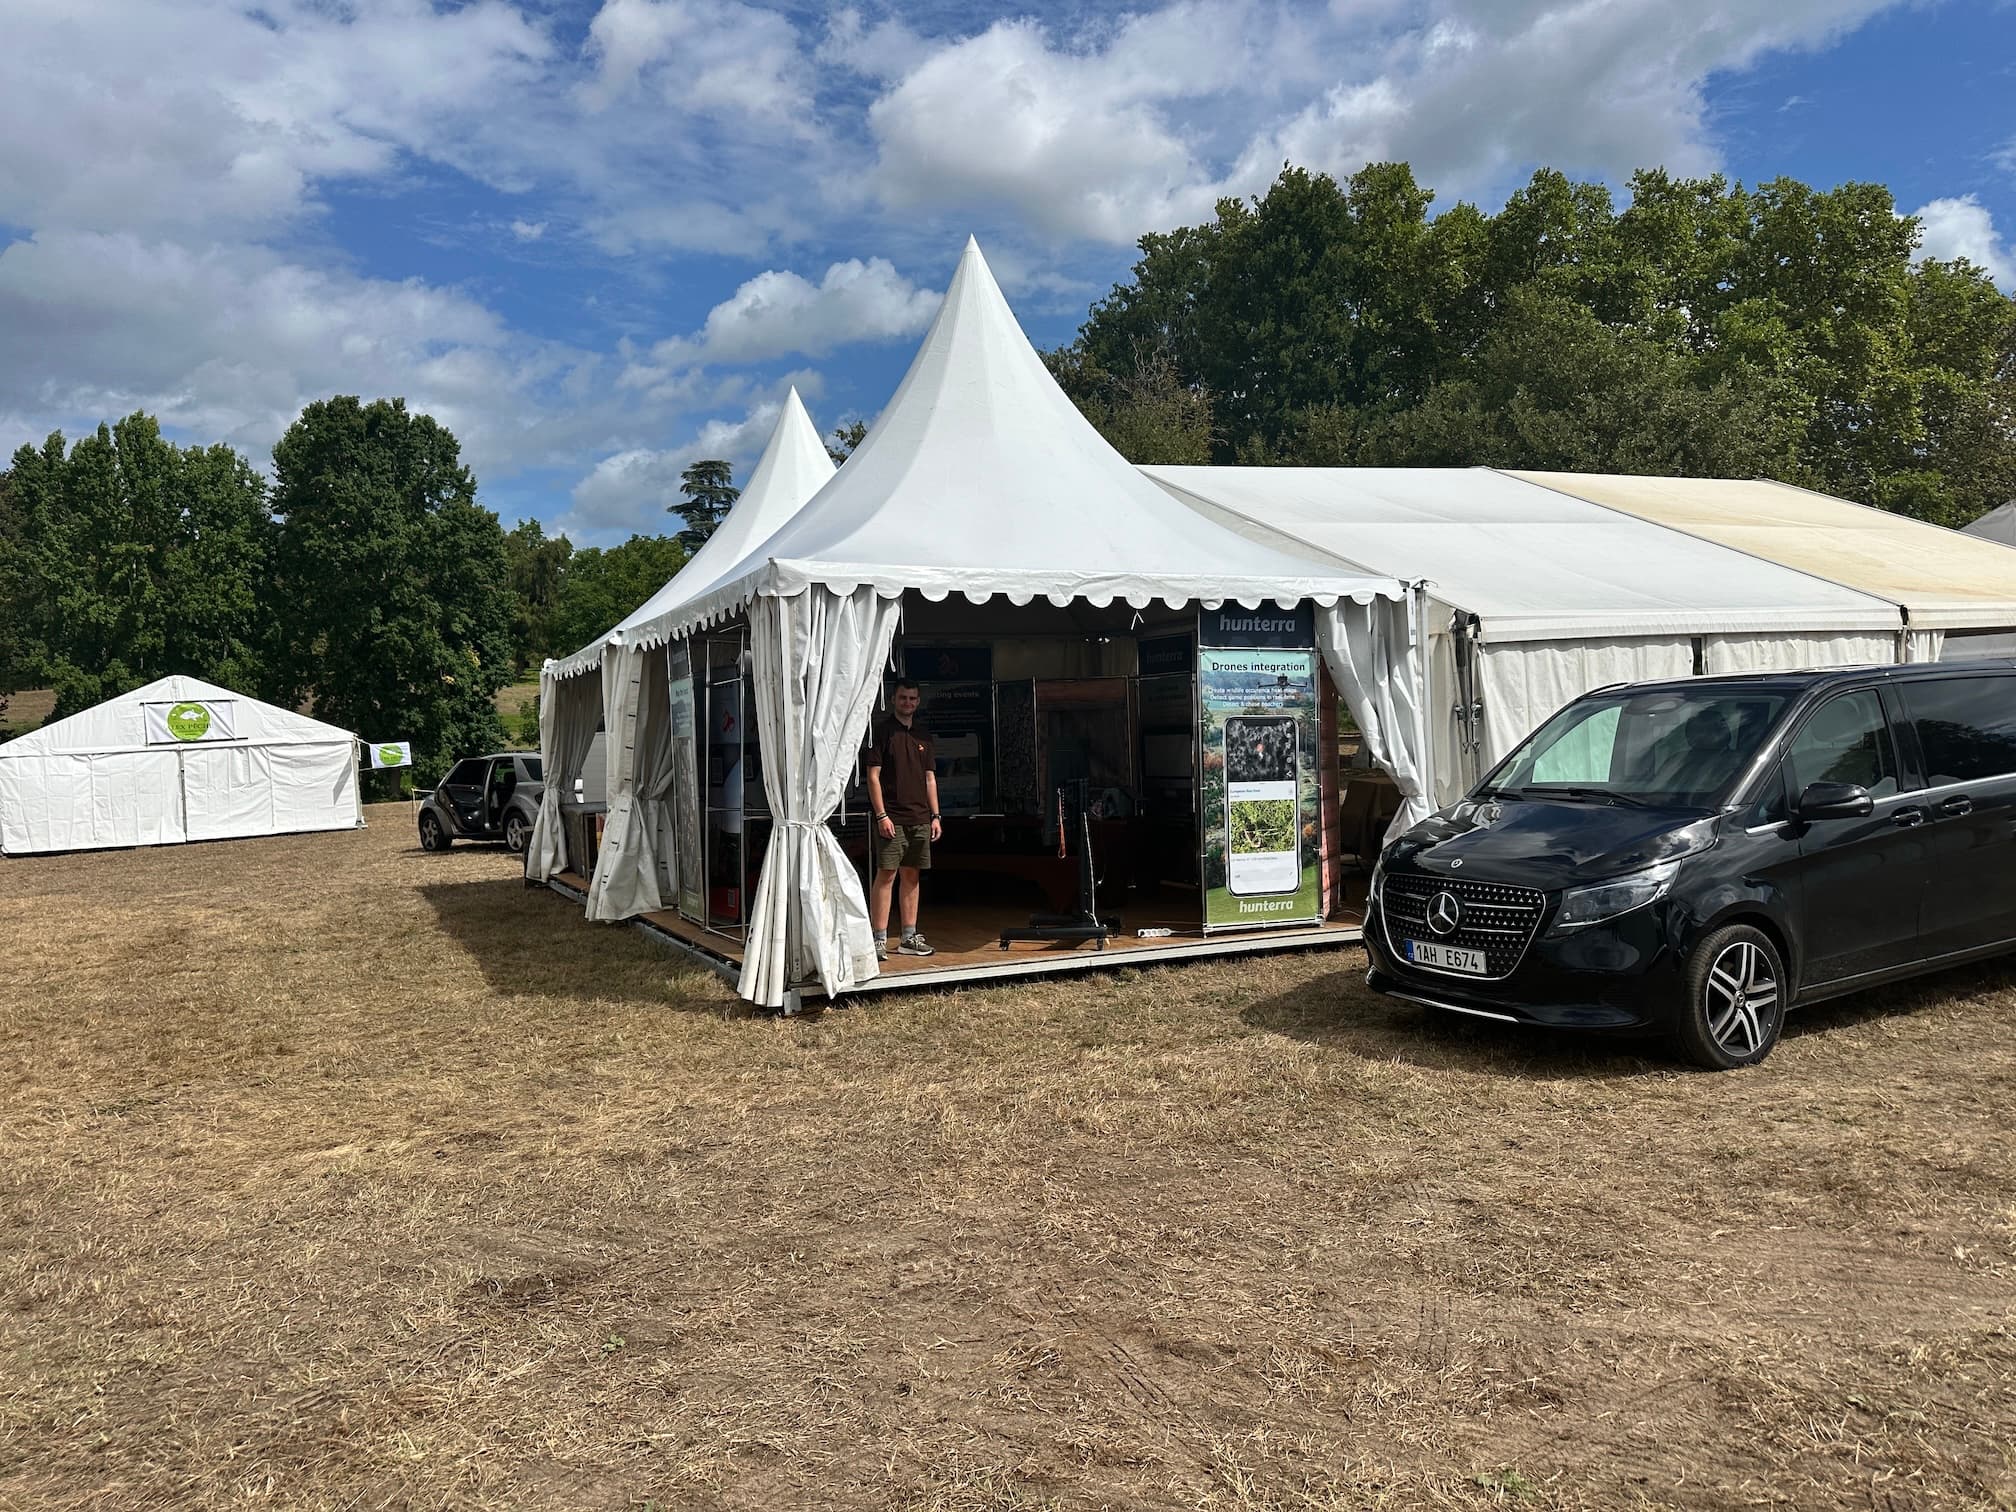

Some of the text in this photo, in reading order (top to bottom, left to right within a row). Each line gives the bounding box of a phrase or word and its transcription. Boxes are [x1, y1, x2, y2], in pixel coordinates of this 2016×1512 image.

[1220, 615, 1295, 632] hunterra
[1212, 662, 1305, 673] Drones integration
[1239, 900, 1294, 913] hunterra
[1416, 944, 1479, 970] 1AH E674
